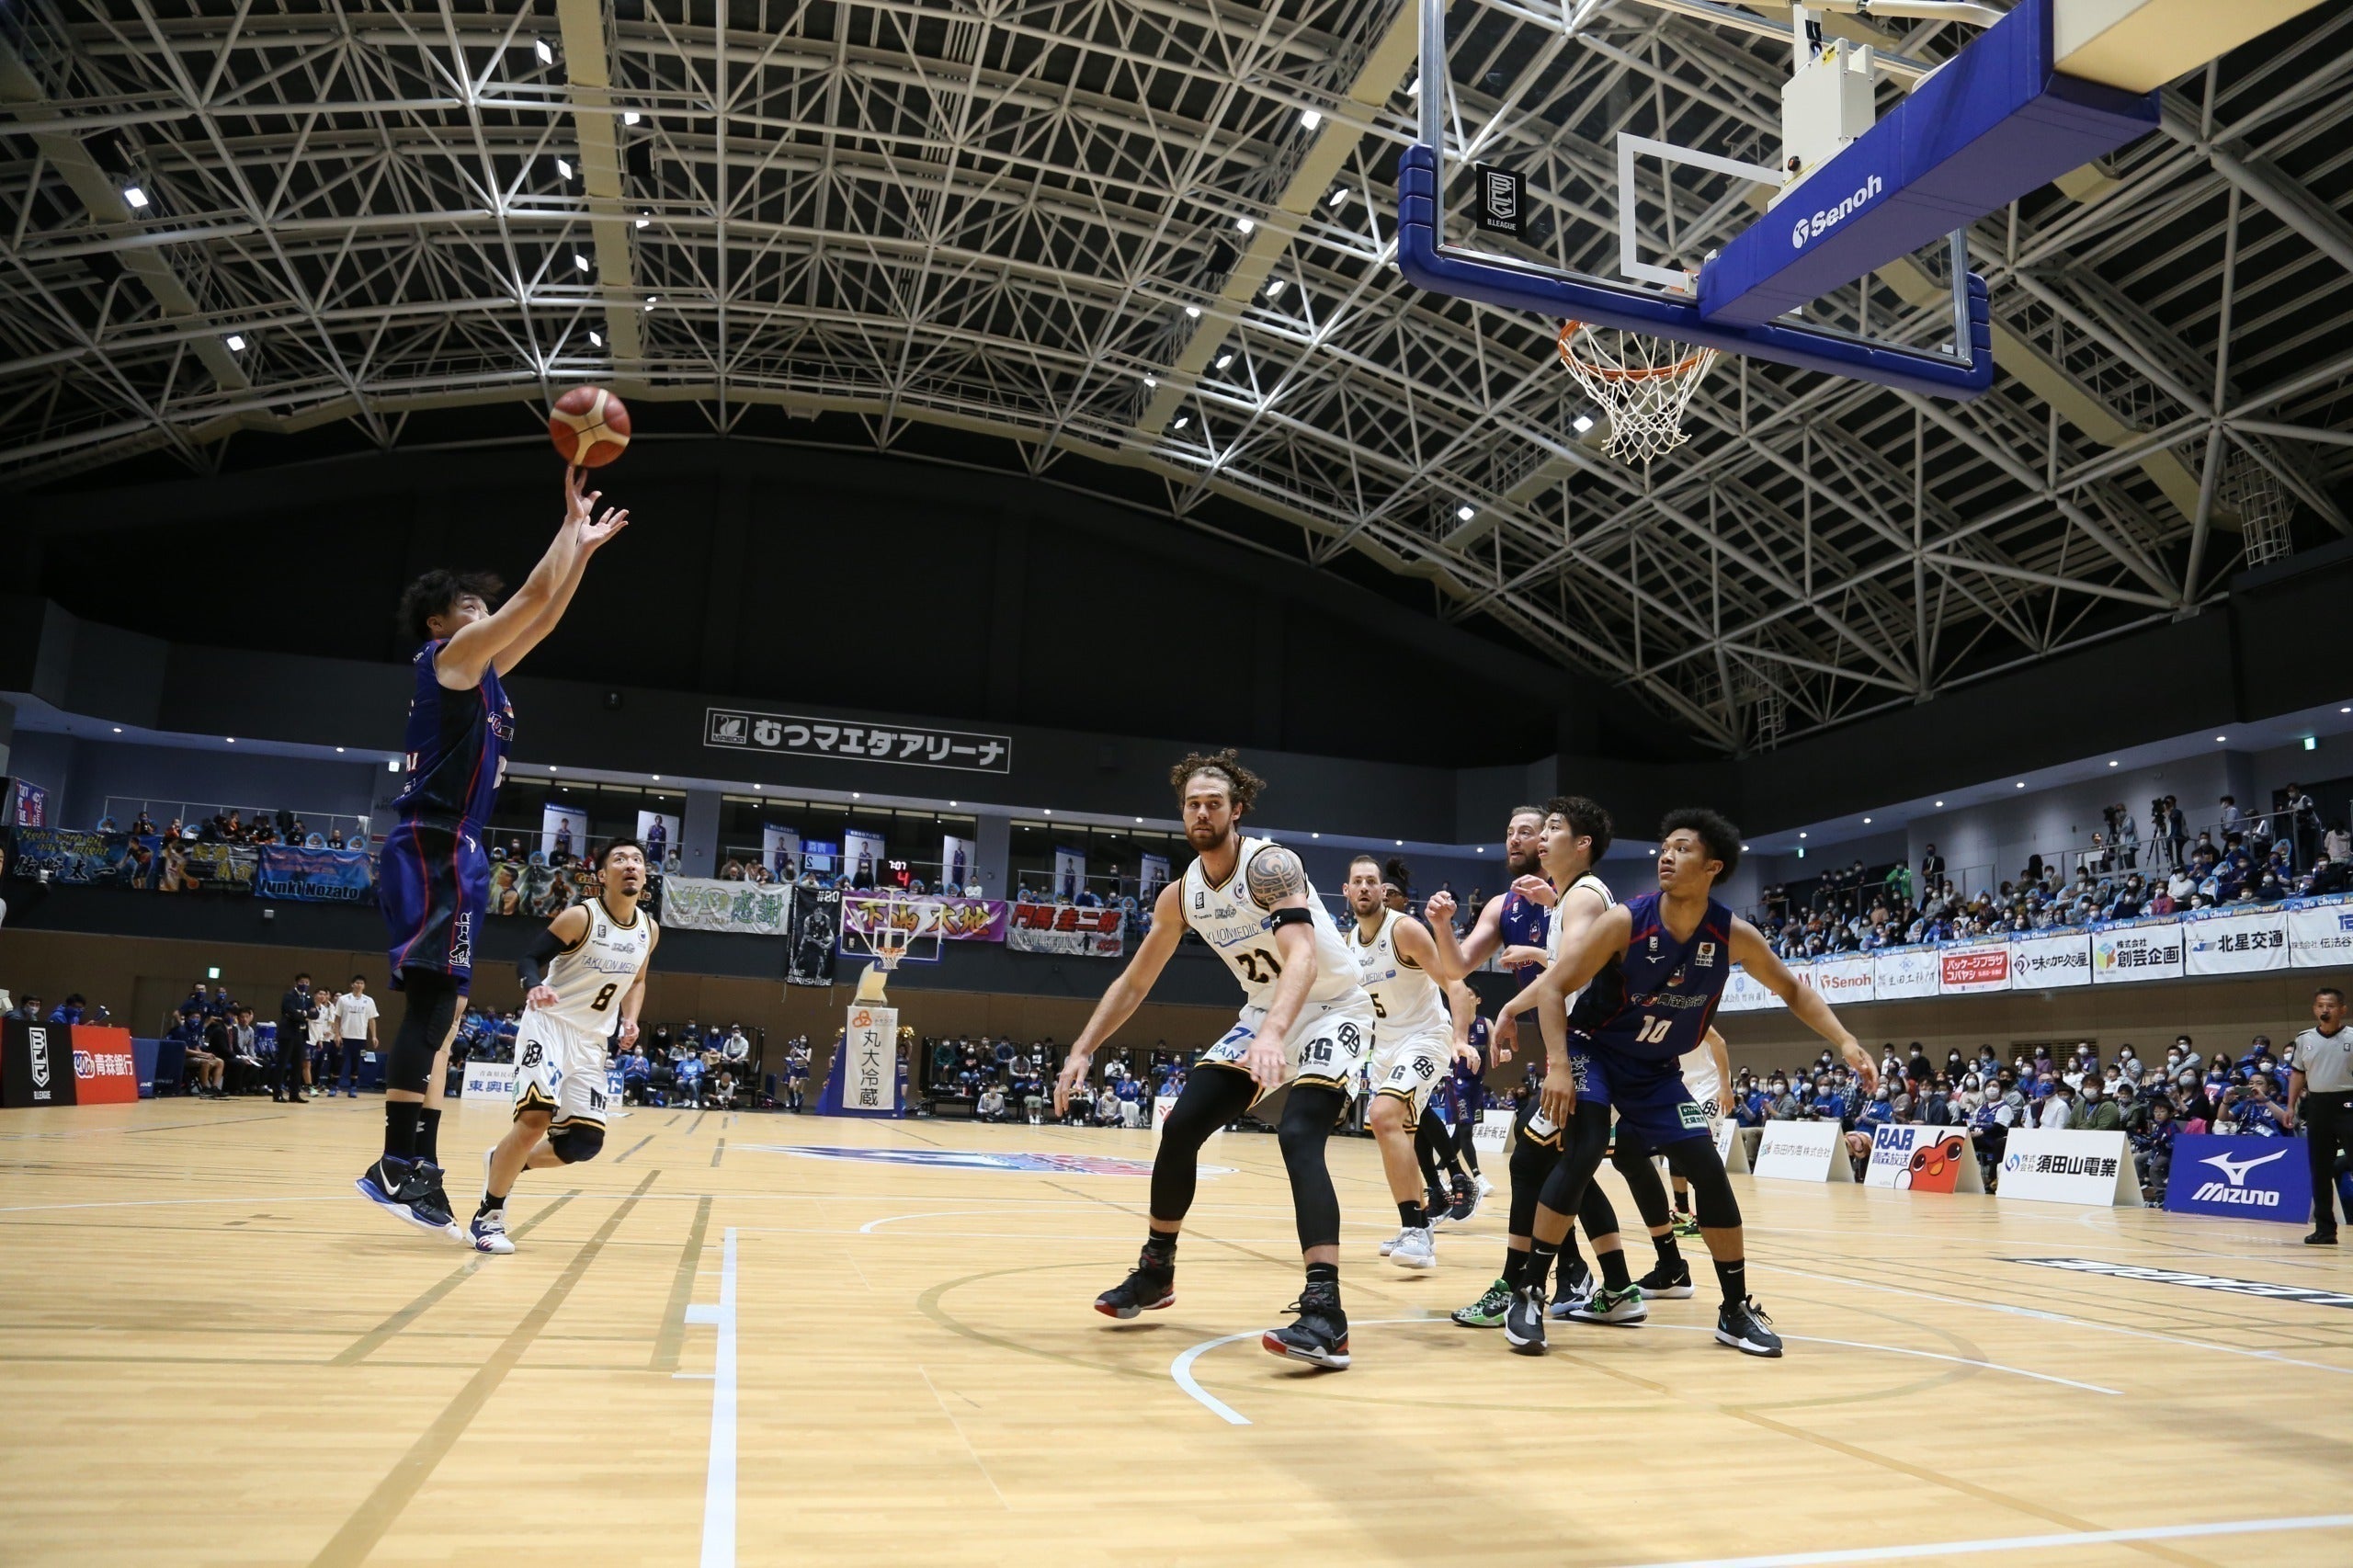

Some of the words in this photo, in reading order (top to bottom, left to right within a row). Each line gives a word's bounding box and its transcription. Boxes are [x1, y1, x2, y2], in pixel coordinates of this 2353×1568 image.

[1812, 175, 1882, 237] Senoh
[1487, 218, 1517, 231] B.LEAGUE
[754, 720, 1005, 766] むつマエダアリーナ
[889, 860, 906, 870] 7:07
[897, 872, 909, 886] 4
[305, 882, 359, 900] Nozato
[817, 891, 840, 903] #80
[2117, 938, 2147, 949] 株式会社
[2218, 930, 2283, 952] 北星交通
[2320, 937, 2353, 949] 伝法谷
[1234, 949, 1281, 983] 21
[2117, 946, 2179, 968] 創芸企画
[1832, 974, 1871, 988] Senoh
[1947, 970, 1976, 981] コバヤシ
[591, 983, 617, 1011] 8
[1370, 993, 1387, 1018] 5
[1635, 1015, 1672, 1043] 10
[95, 1054, 133, 1076] 青森銀行
[859, 1029, 881, 1106] 丸大冷蔵
[1413, 1056, 1435, 1081] 89
[1703, 1101, 1718, 1117] 89
[1875, 1128, 1915, 1151] RAB
[1871, 1152, 1910, 1167] 青森放送
[2020, 1164, 2034, 1172] 会社
[2022, 1154, 2036, 1163] 株式
[2036, 1154, 2118, 1177] 須田山電業
